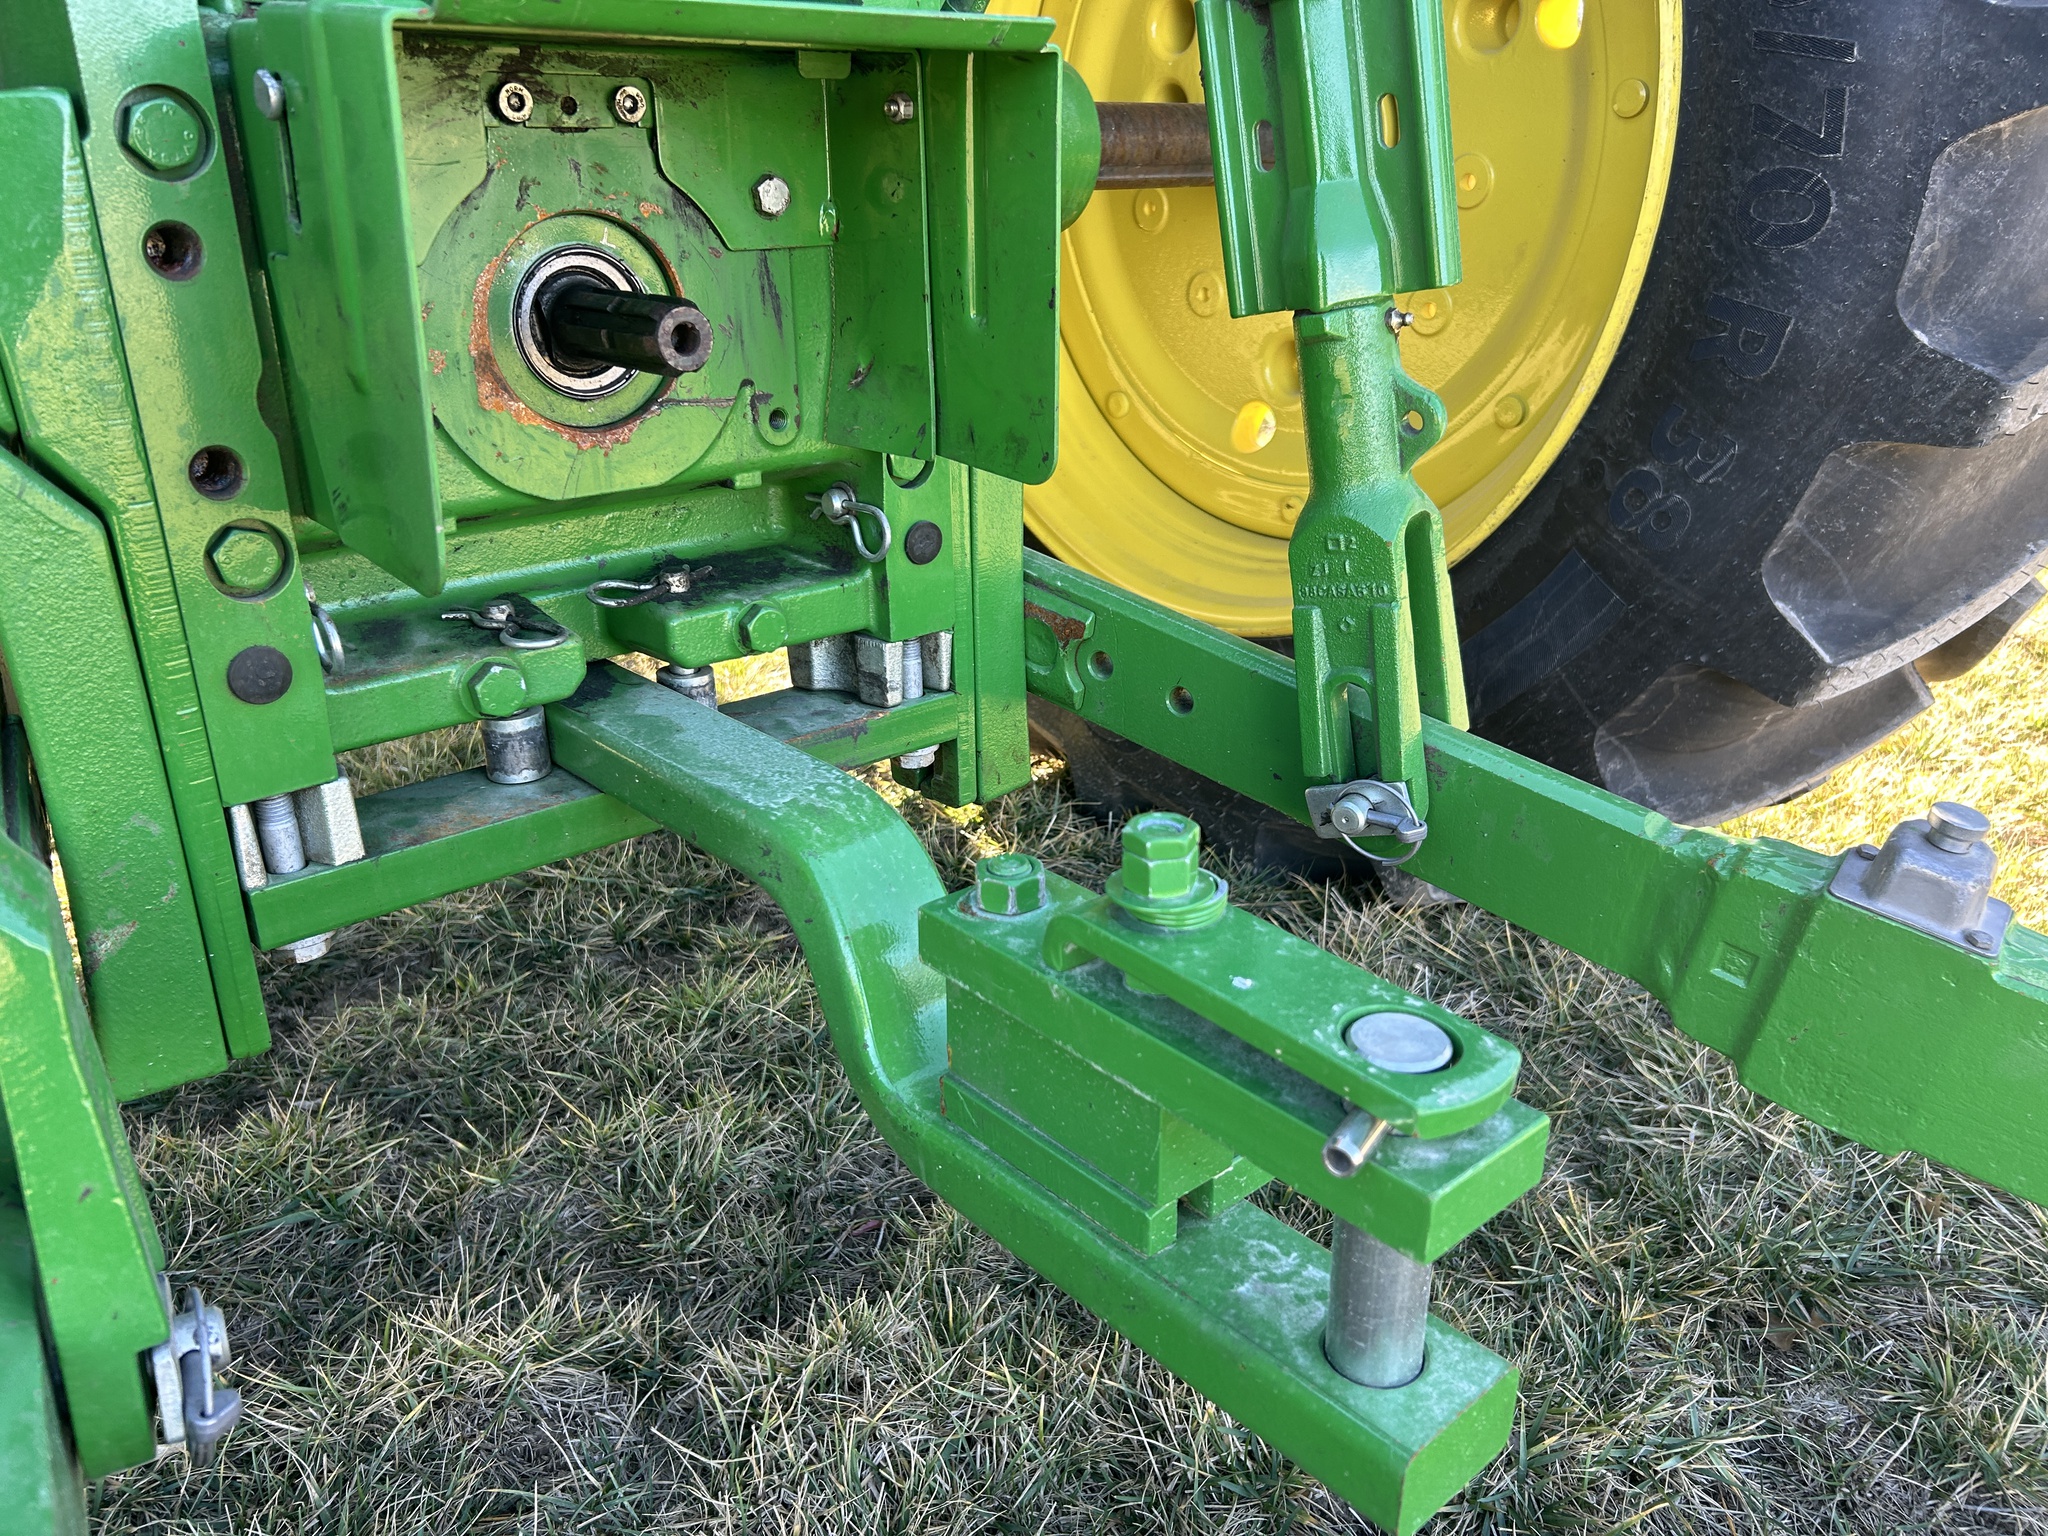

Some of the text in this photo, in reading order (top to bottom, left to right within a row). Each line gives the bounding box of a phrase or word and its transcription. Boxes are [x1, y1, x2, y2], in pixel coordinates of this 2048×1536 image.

[1609, 0, 1858, 551] /70 R 38
